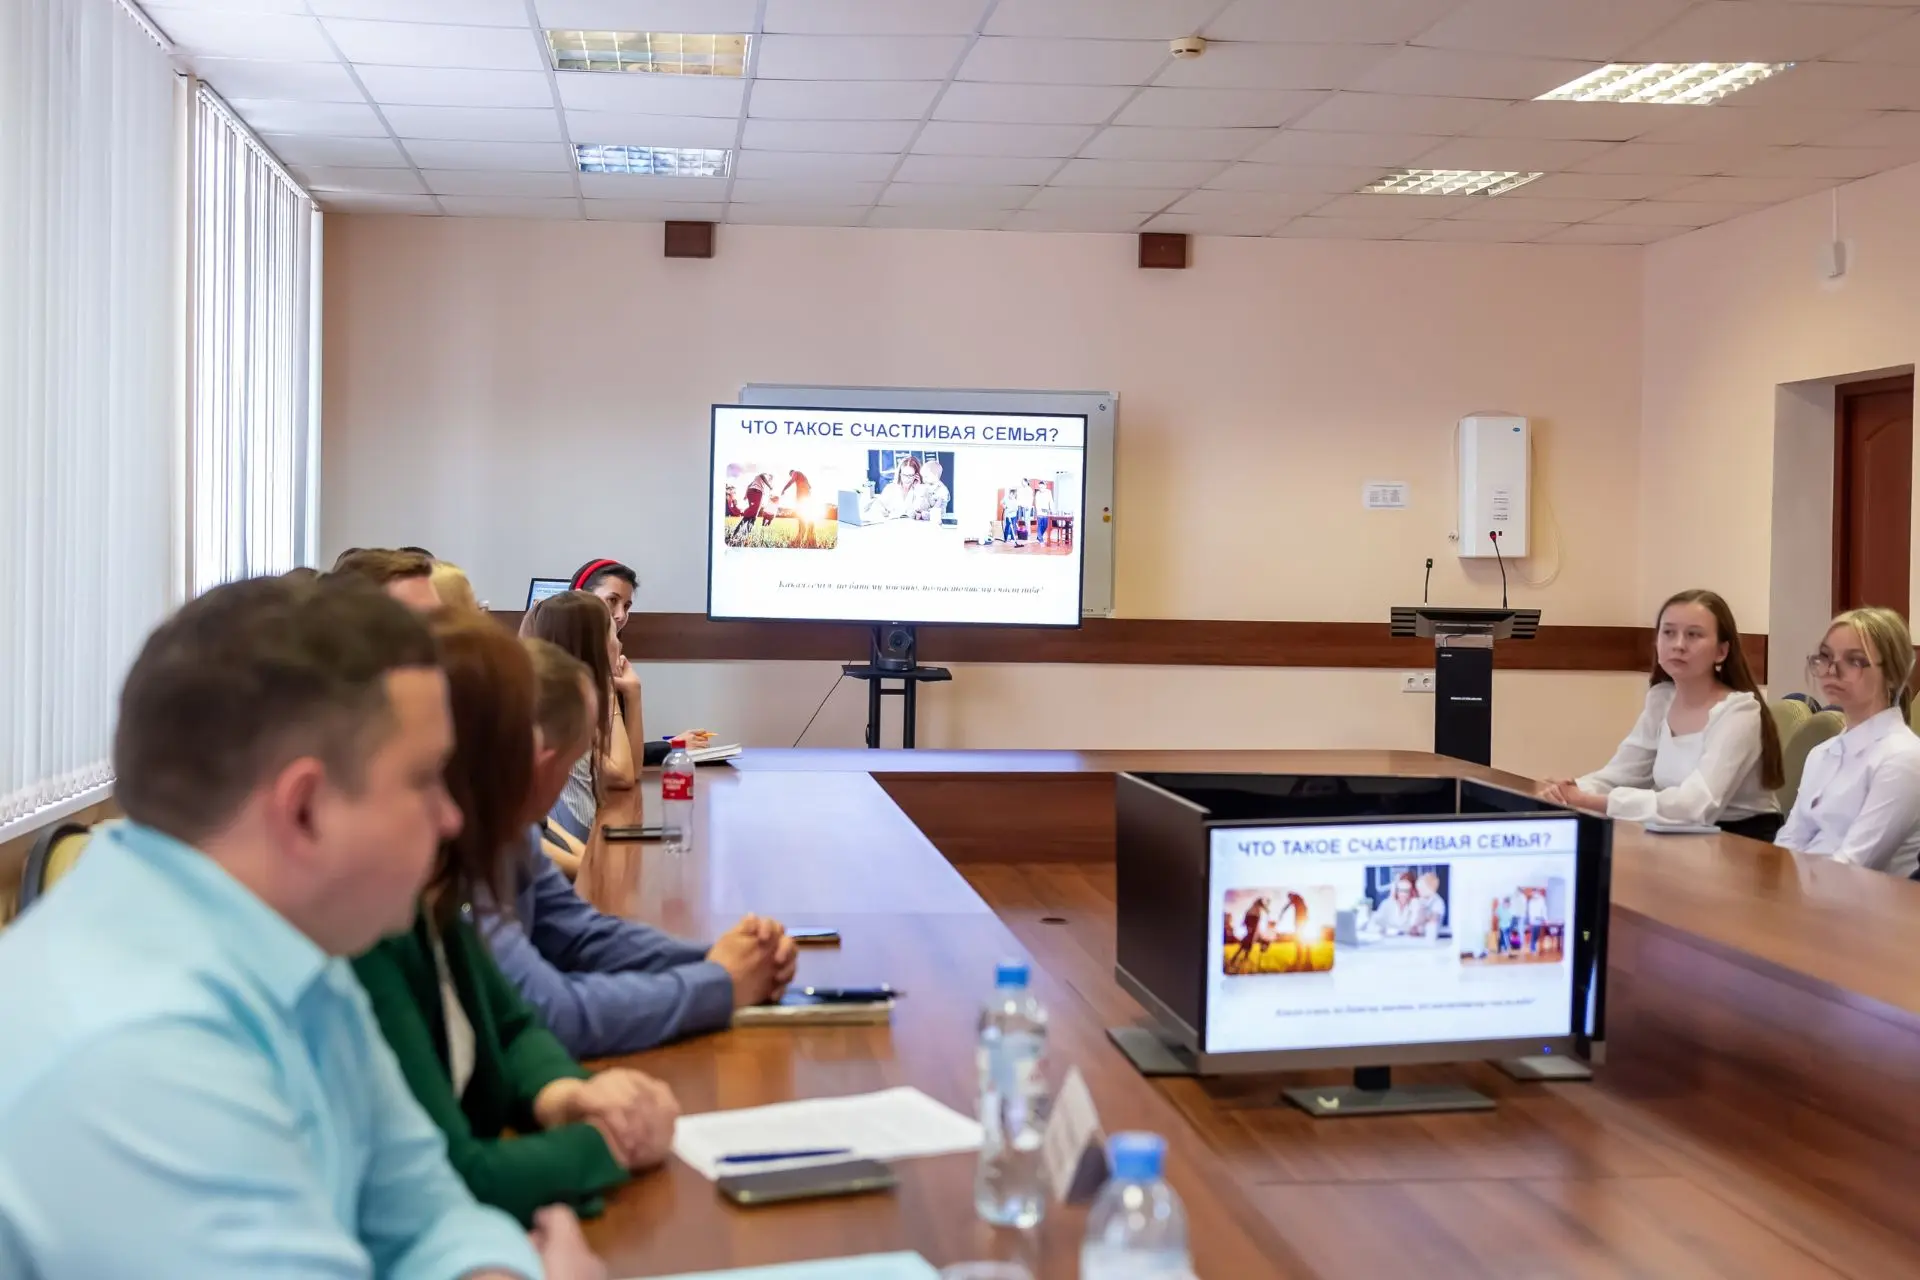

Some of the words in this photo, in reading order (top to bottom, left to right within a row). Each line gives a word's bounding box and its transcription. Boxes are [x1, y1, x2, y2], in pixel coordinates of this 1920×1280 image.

[741, 419, 778, 435] ЧТО
[784, 421, 843, 436] ТАКОЕ
[850, 423, 976, 440] СЧАСТЛИВАЯ
[982, 426, 1059, 442] СЕМЬЯ?
[1238, 839, 1276, 857] ЧТО
[1281, 838, 1341, 855] ТАКОЕ
[1347, 834, 1471, 853] СЧАСТЛИВАЯ
[1477, 832, 1552, 849] СЕМЬЯ?
